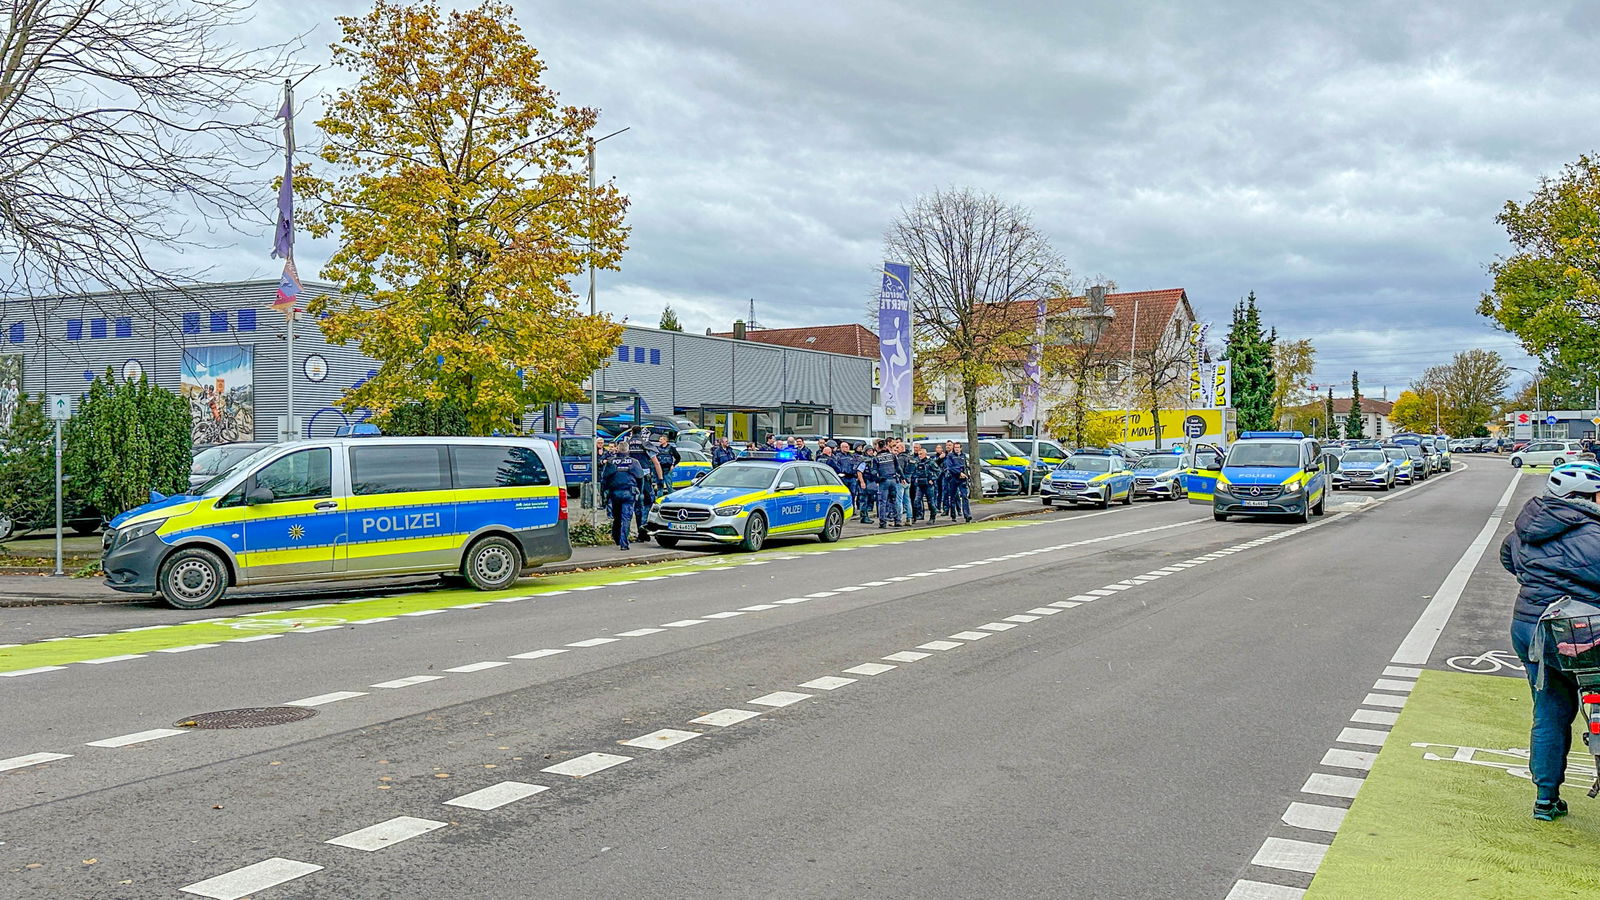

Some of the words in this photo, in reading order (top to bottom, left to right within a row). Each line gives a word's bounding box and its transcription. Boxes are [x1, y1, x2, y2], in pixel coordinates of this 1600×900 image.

[1130, 414, 1140, 424] TO
[1131, 426, 1155, 437] MOVE
[781, 504, 803, 516] POLIZEI
[362, 512, 441, 534] POLIZEI
